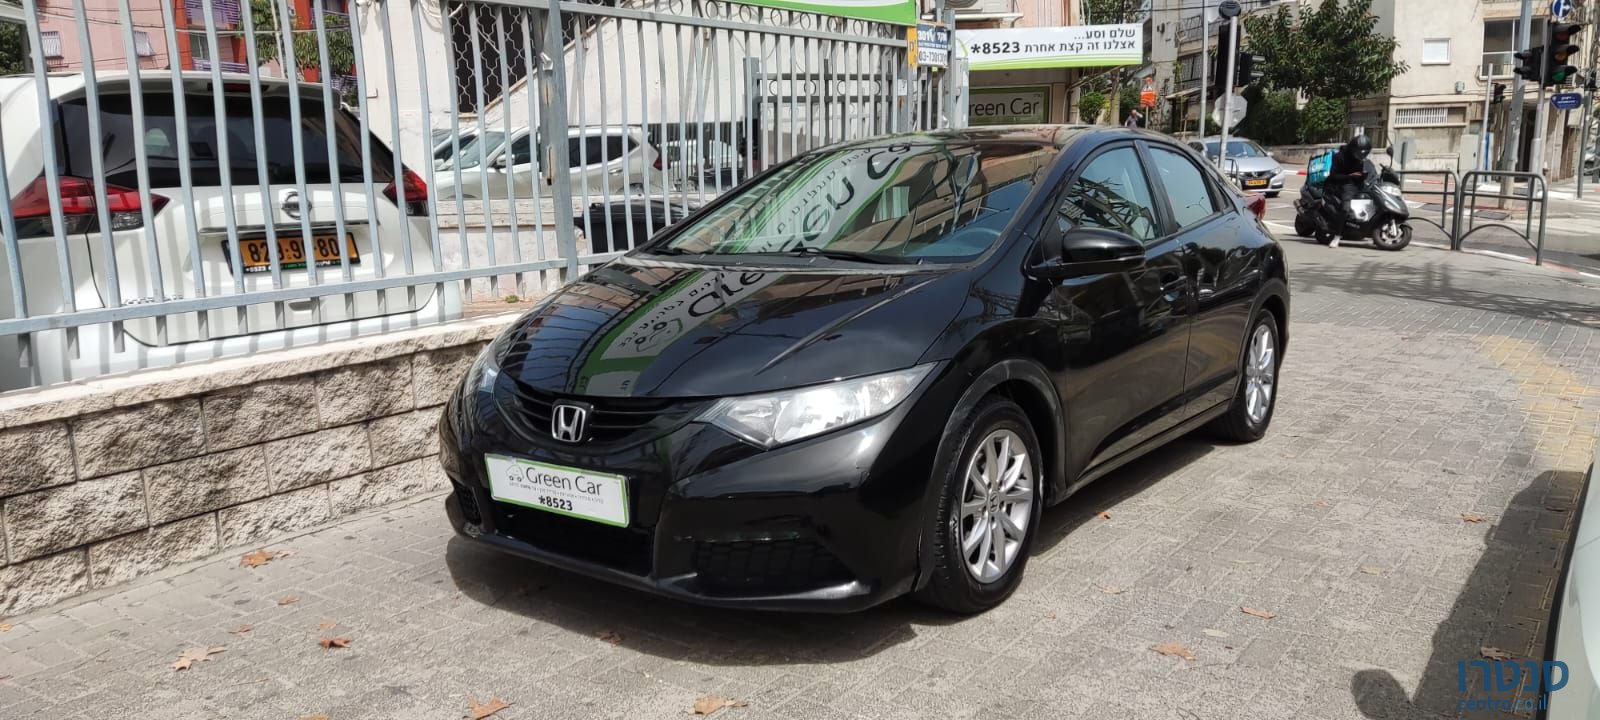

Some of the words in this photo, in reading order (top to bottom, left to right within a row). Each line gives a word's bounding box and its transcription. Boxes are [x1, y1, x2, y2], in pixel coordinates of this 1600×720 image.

[1109, 28, 1136, 39] שלם
[1024, 43, 1056, 53] אחרת
[1059, 42, 1084, 53] קצת
[1087, 42, 1100, 51] זה
[1103, 40, 1136, 50] אצלנו
[968, 102, 1006, 117] reen
[1010, 97, 1040, 115] Car
[525, 466, 572, 491] Green
[574, 475, 603, 496] Car
